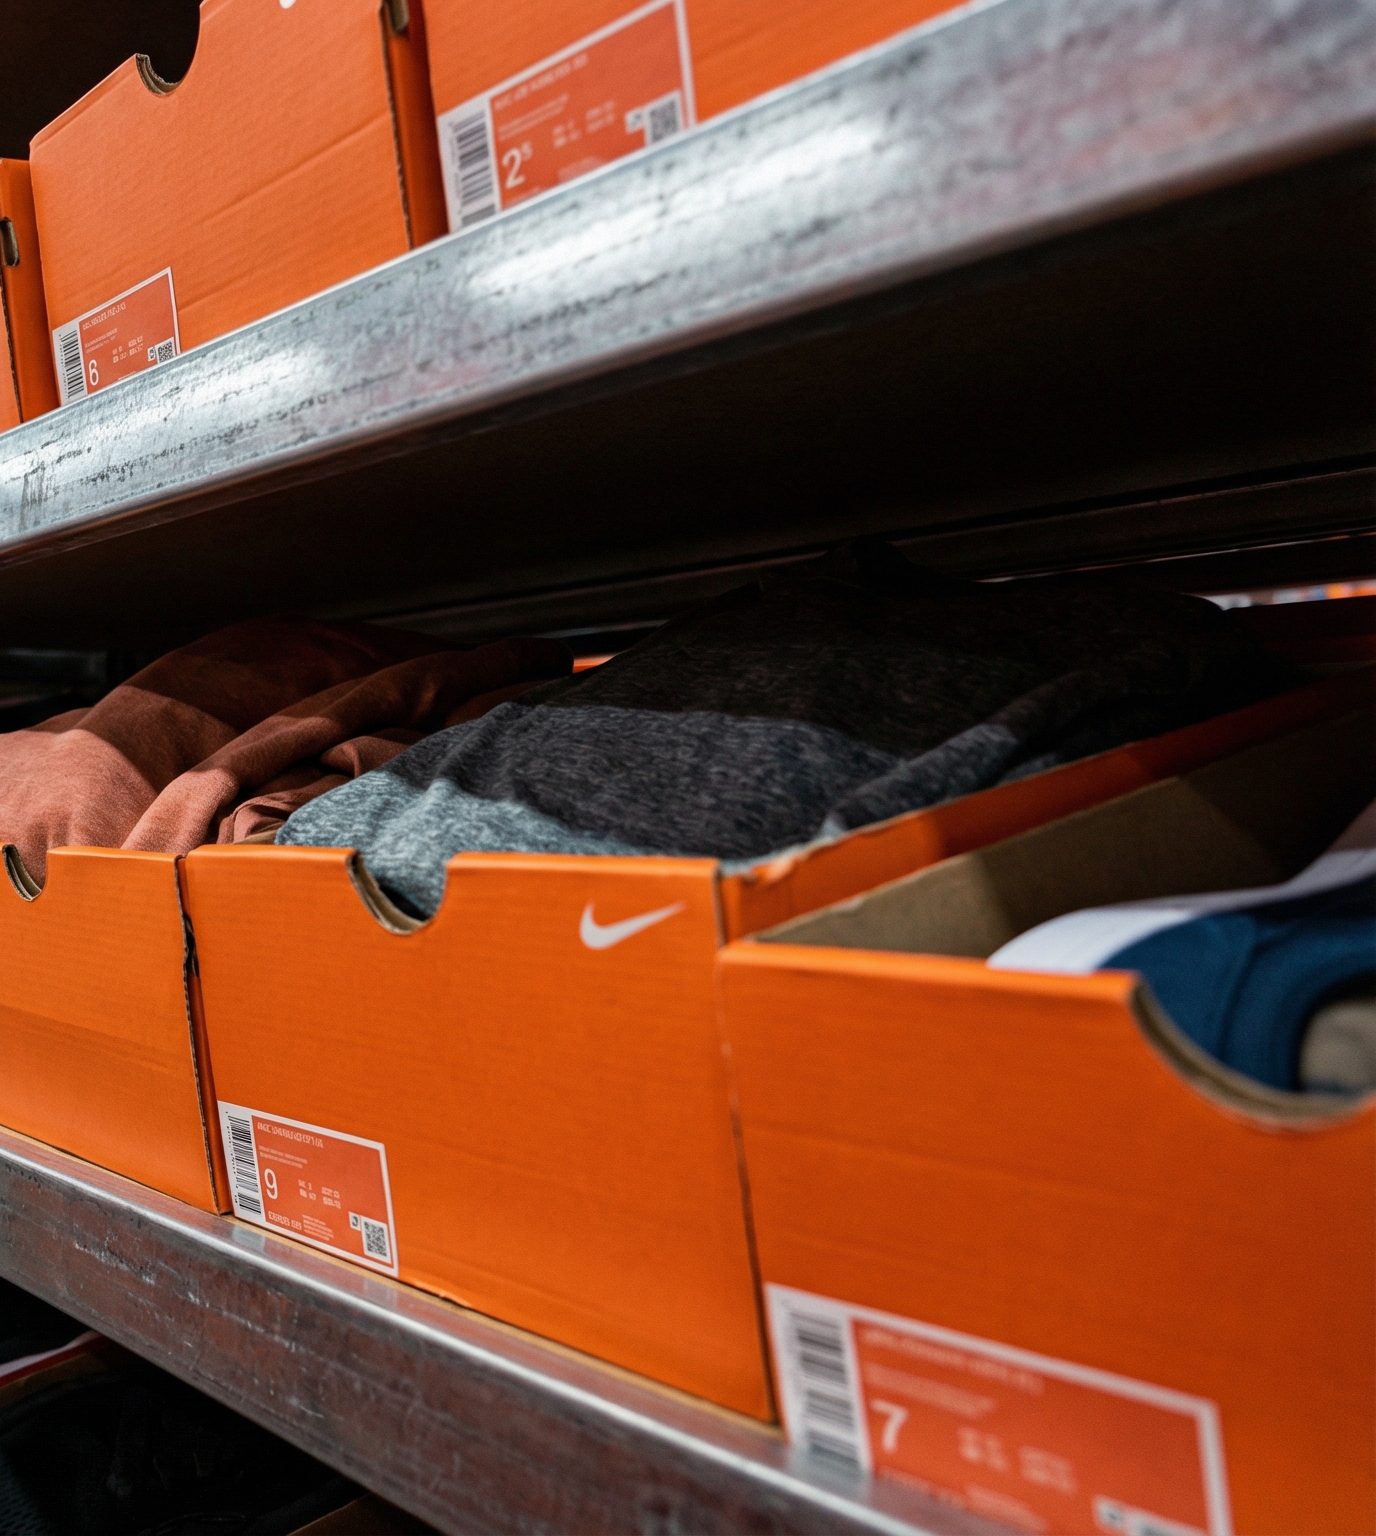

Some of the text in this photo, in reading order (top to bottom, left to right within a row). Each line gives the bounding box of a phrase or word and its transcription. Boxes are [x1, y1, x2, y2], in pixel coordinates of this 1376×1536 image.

[88, 360, 99, 386] 6
[265, 1169, 278, 1200] 9
[871, 1399, 908, 1452] 7
